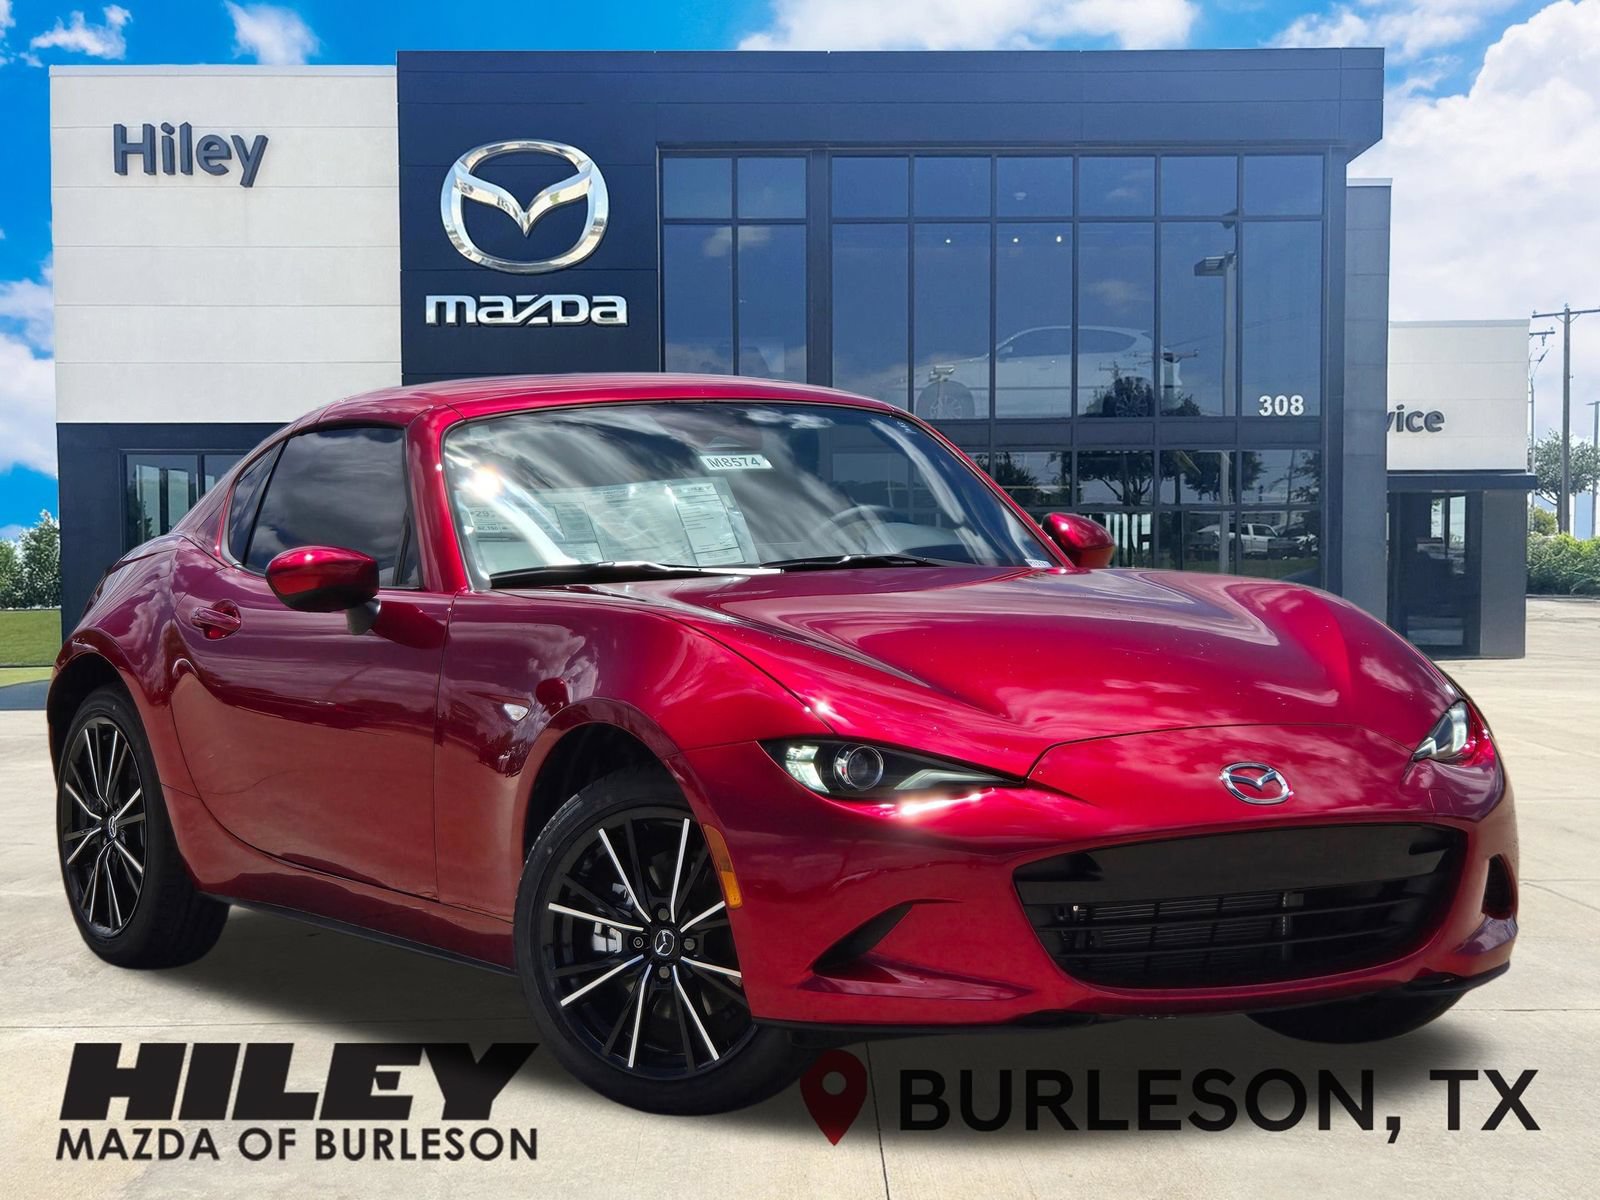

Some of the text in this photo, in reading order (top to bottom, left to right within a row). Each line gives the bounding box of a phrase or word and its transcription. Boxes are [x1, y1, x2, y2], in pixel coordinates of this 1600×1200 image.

[113, 122, 269, 188] Hiley
[1258, 394, 1305, 417] 308
[707, 456, 761, 469] M8574
